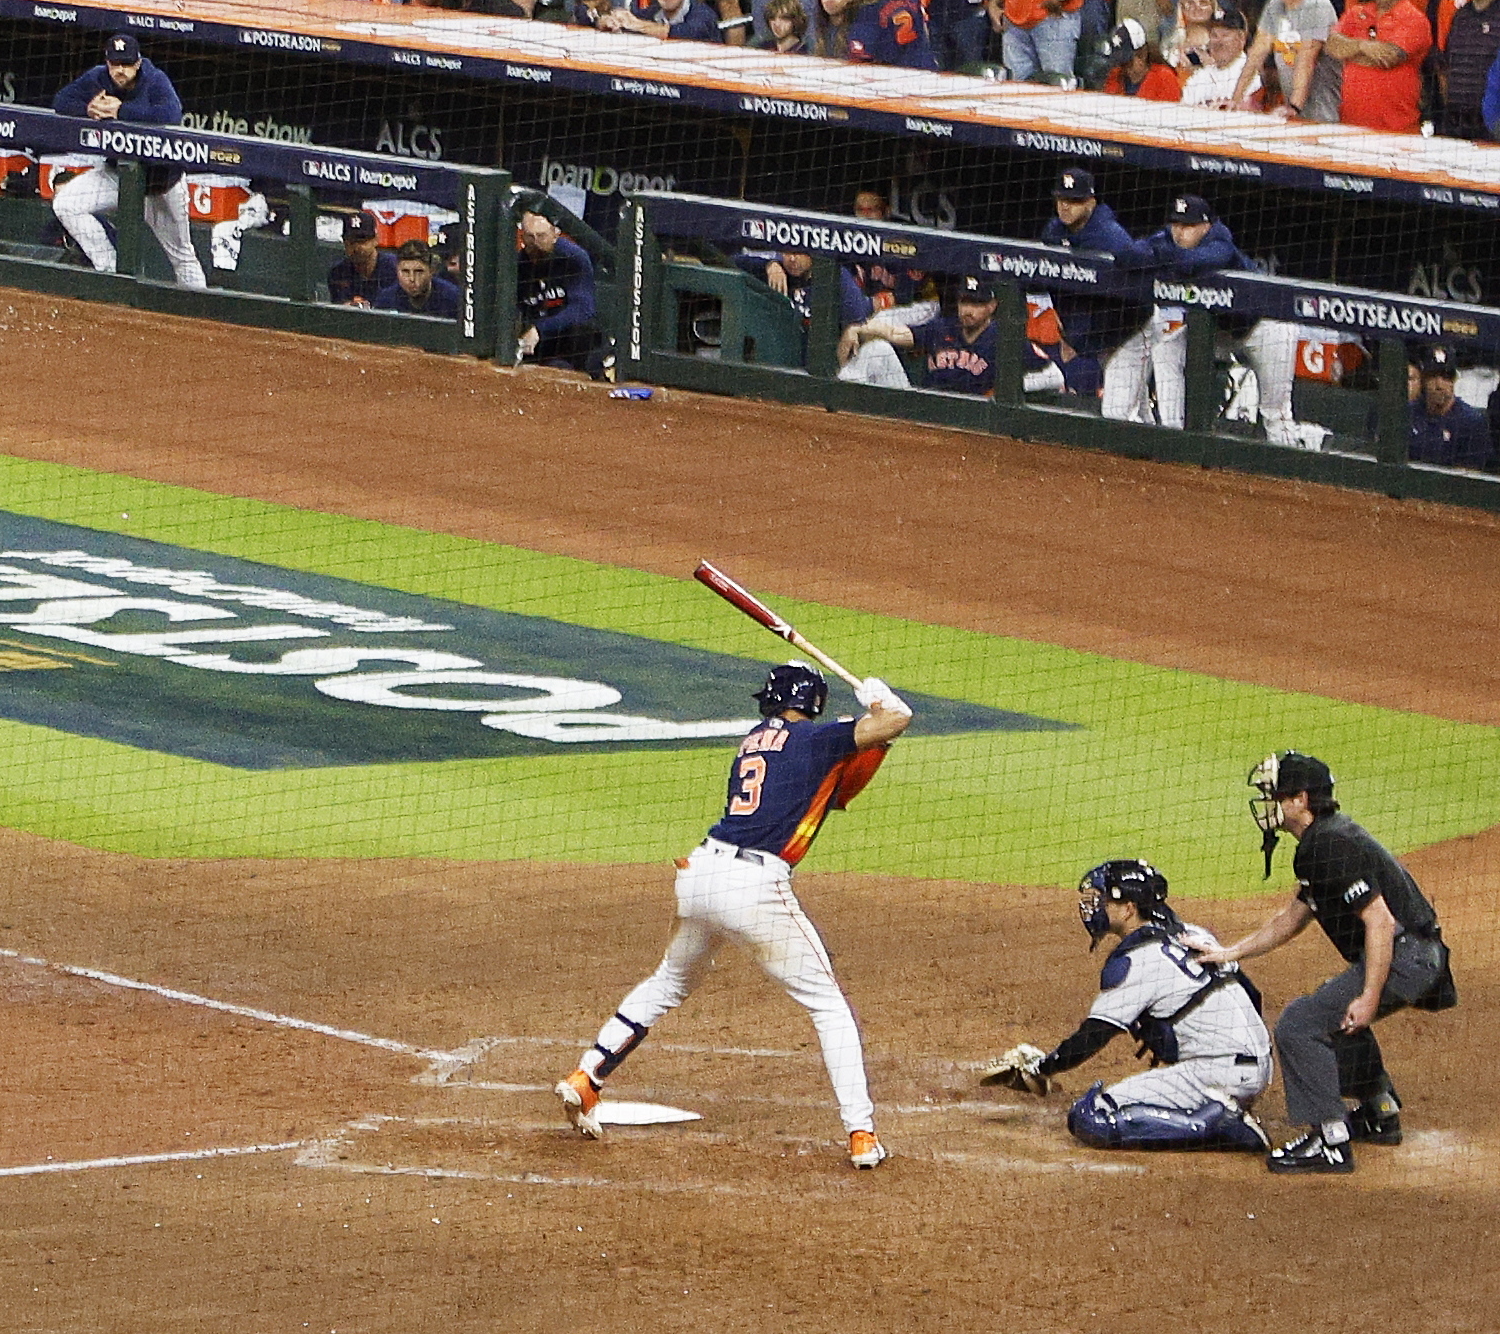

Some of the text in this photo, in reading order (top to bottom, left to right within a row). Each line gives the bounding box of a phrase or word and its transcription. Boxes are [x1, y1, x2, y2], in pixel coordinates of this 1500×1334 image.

[34, 5, 77, 24] loanDepot
[135, 16, 155, 29] ALCS
[252, 31, 321, 54] POSTSEASON
[507, 64, 552, 84] loanDepot
[753, 96, 828, 121] POSTSEASON
[212, 111, 249, 137] the
[102, 130, 209, 164] POSTSEASON
[376, 119, 442, 160] ALCS
[1025, 133, 1103, 157] POSTSEASON
[320, 162, 417, 192] ALCS loanDepot
[765, 219, 882, 257] POSTSEASON
[464, 184, 476, 339] ASTROS.COM
[1002, 255, 1037, 278] enjoy
[1038, 258, 1060, 279] the
[631, 205, 645, 361] ASTROS.COM
[1153, 279, 1234, 308] loanDepot
[1408, 264, 1482, 303] ALCS
[1318, 299, 1442, 336] POSTSEASON
[730, 754, 767, 816] 3
